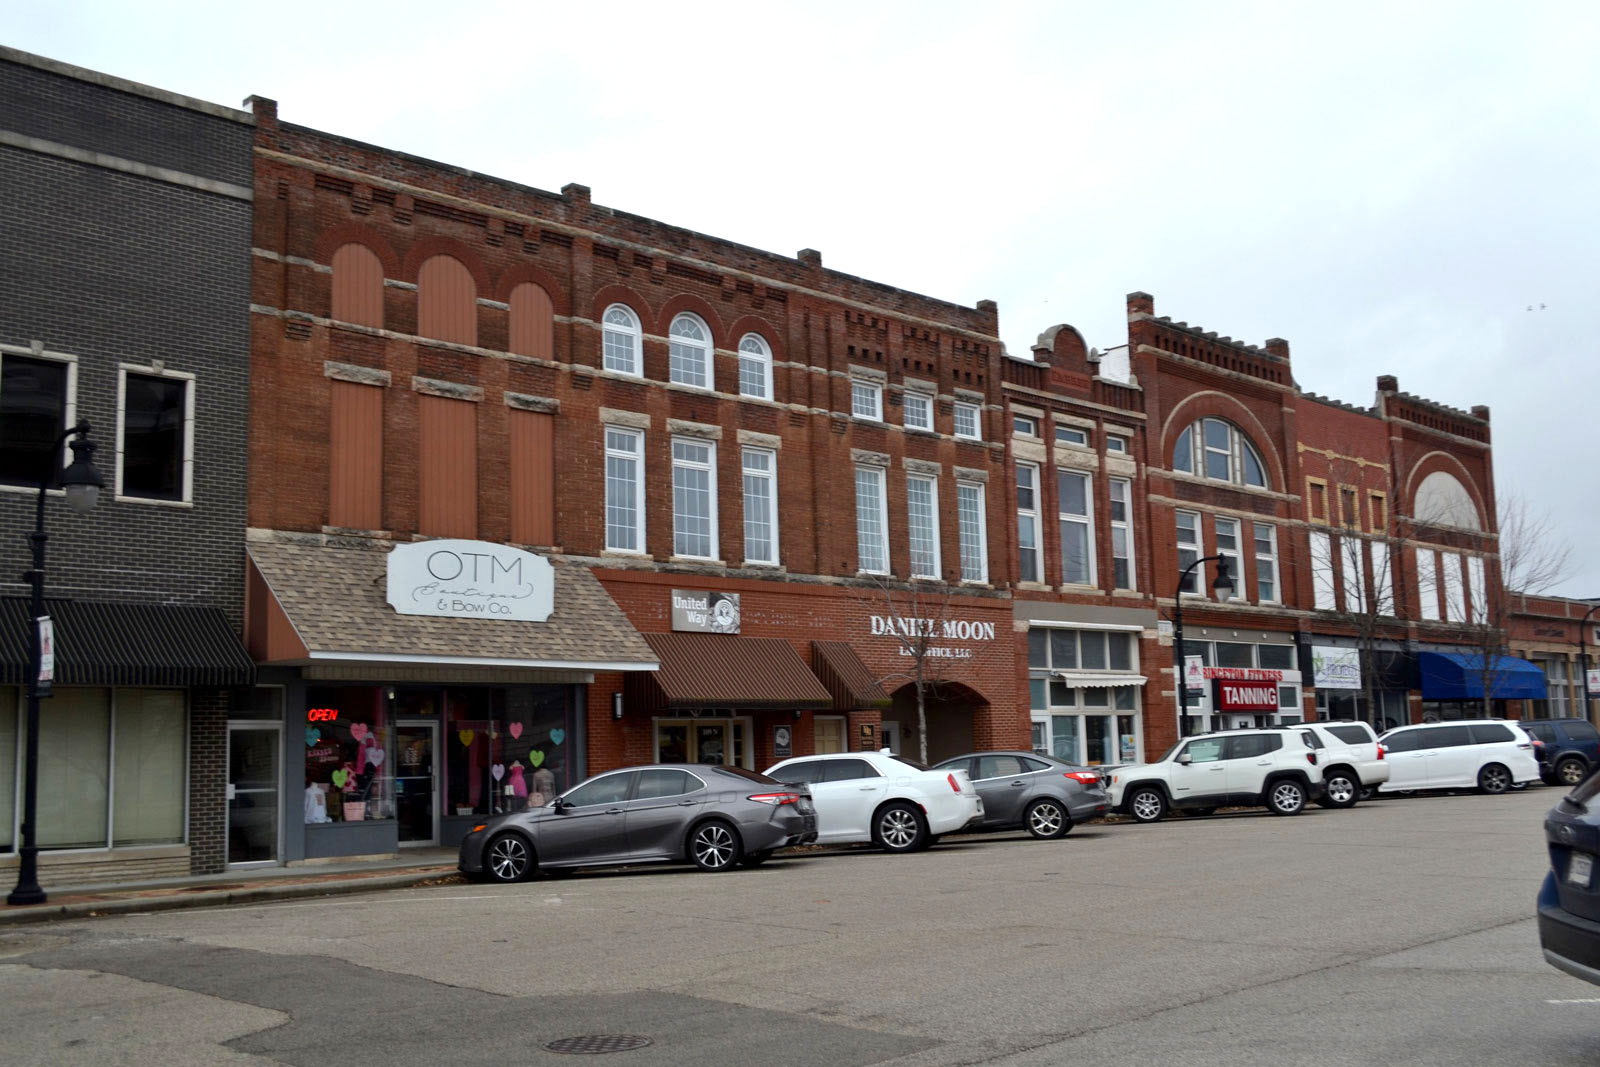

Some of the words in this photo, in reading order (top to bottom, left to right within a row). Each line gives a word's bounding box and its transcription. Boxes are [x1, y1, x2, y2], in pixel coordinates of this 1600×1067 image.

[427, 550, 521, 585] OTM
[412, 582, 534, 601] Boutique
[437, 599, 447, 611] &
[452, 600, 485, 612] Bow
[489, 602, 512, 615] Co.
[673, 596, 708, 610] United
[686, 610, 708, 627] Way
[943, 620, 995, 640] MOON
[1203, 667, 1245, 680] RINCETON
[1247, 669, 1283, 681] FITNESS
[1223, 686, 1277, 705] TANNING
[308, 708, 338, 721] OPEN
